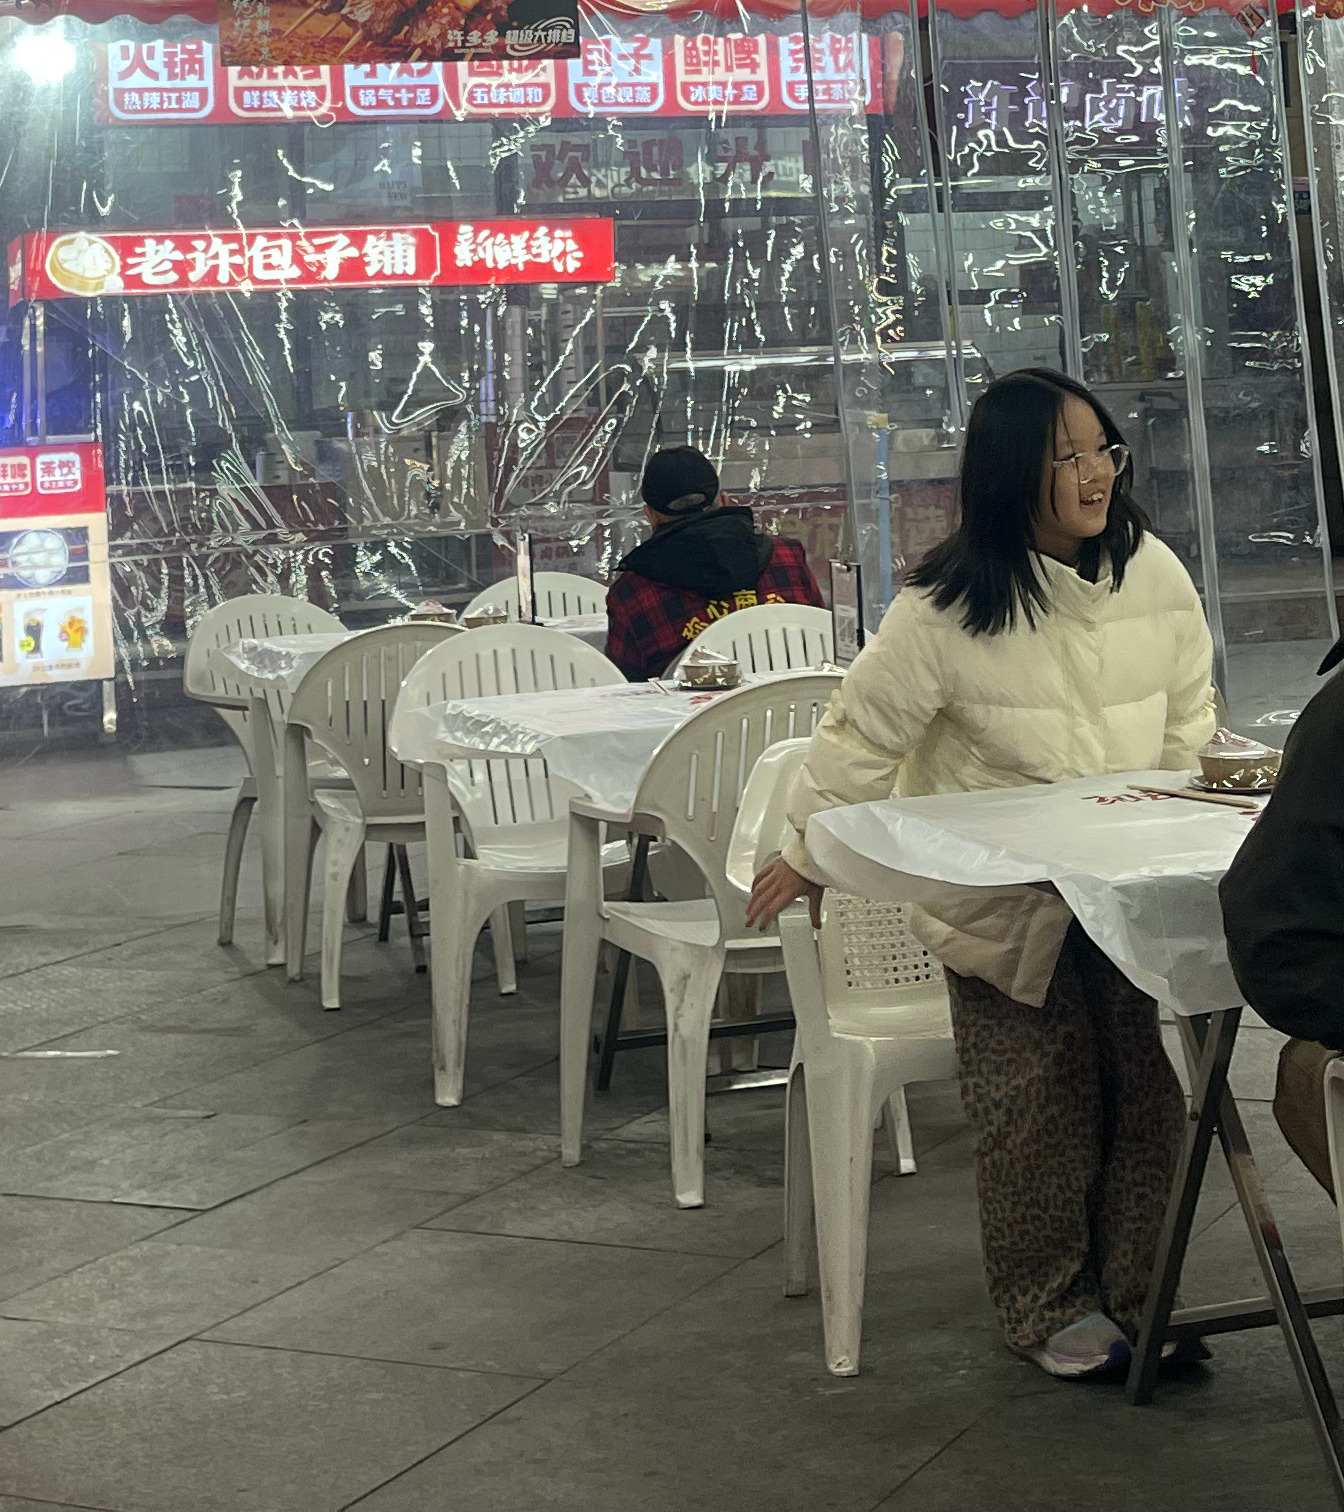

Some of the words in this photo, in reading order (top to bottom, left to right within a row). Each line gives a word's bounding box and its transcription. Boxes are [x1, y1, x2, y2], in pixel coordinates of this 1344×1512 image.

[117, 42, 206, 82] 火锅
[124, 91, 201, 110] 热辣江湖
[358, 88, 432, 107] 锅气十足
[126, 233, 418, 285] 老许包子铺
[41, 461, 78, 479] 茶饮
